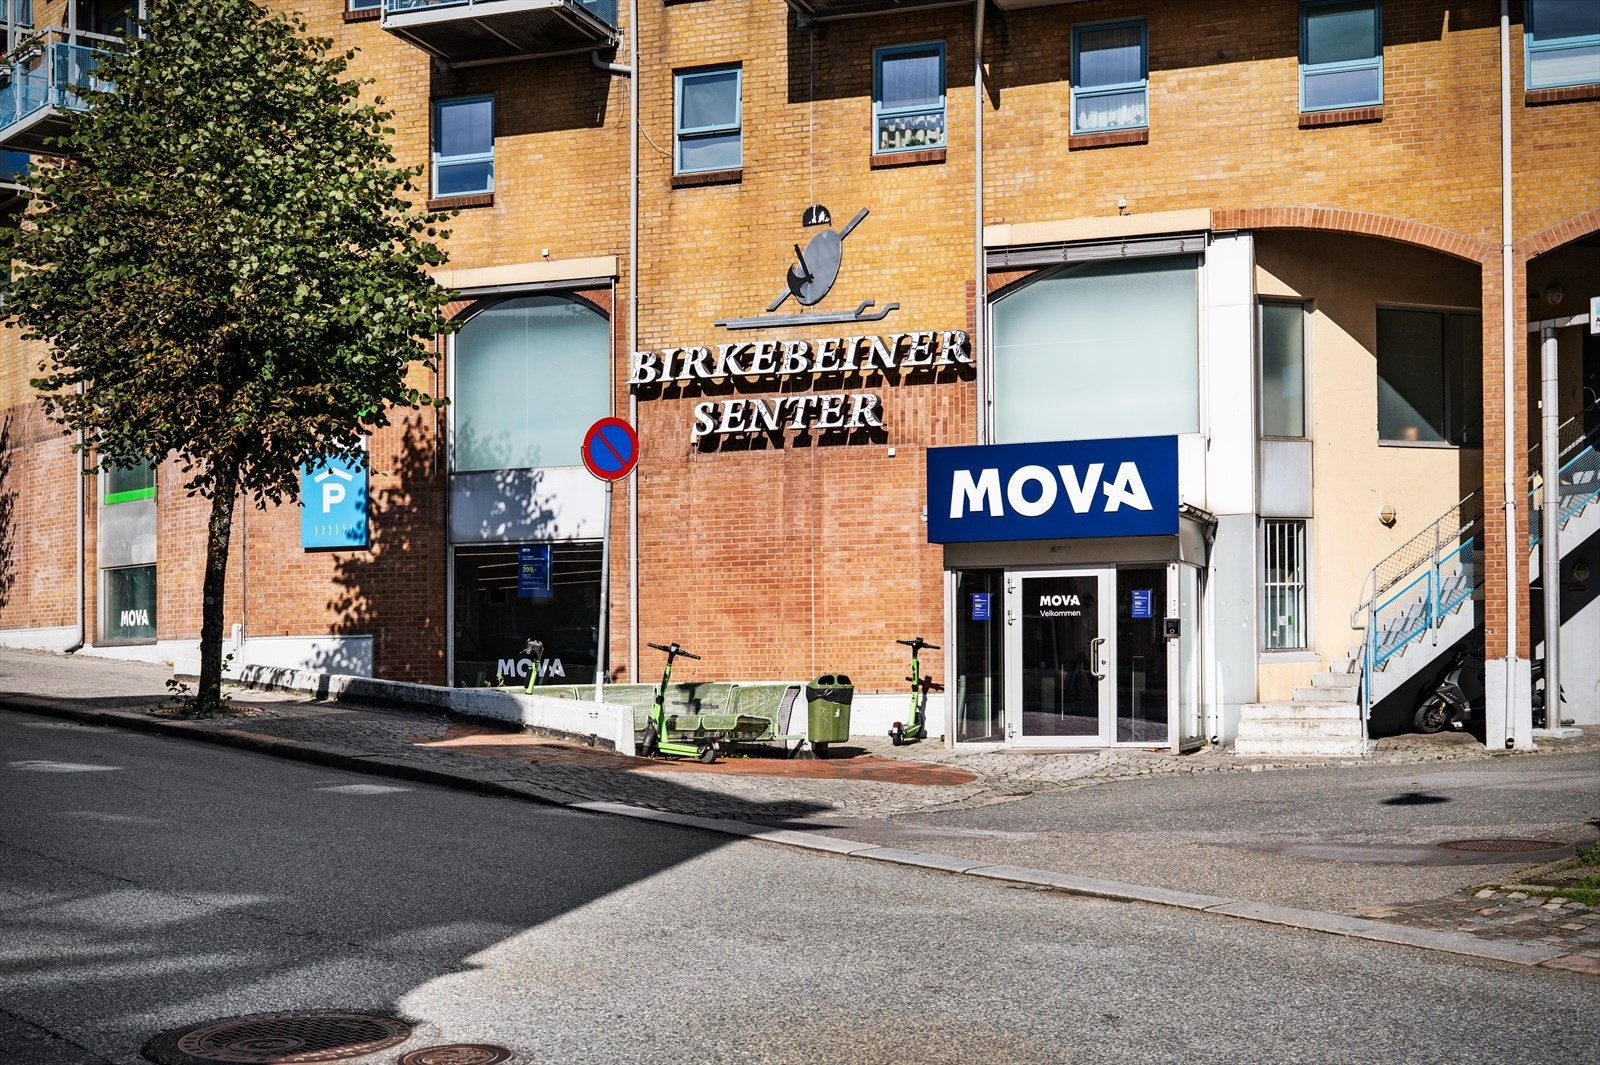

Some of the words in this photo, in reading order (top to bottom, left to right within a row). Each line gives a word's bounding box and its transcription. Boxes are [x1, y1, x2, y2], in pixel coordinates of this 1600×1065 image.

[627, 330, 974, 385] BIRKEBEINER
[693, 393, 883, 436] SENTER
[322, 483, 346, 513] P
[949, 461, 1154, 519] MOVA
[1039, 594, 1081, 607] MOVA
[1039, 609, 1081, 617] Velkommen
[120, 609, 149, 627] MOVA
